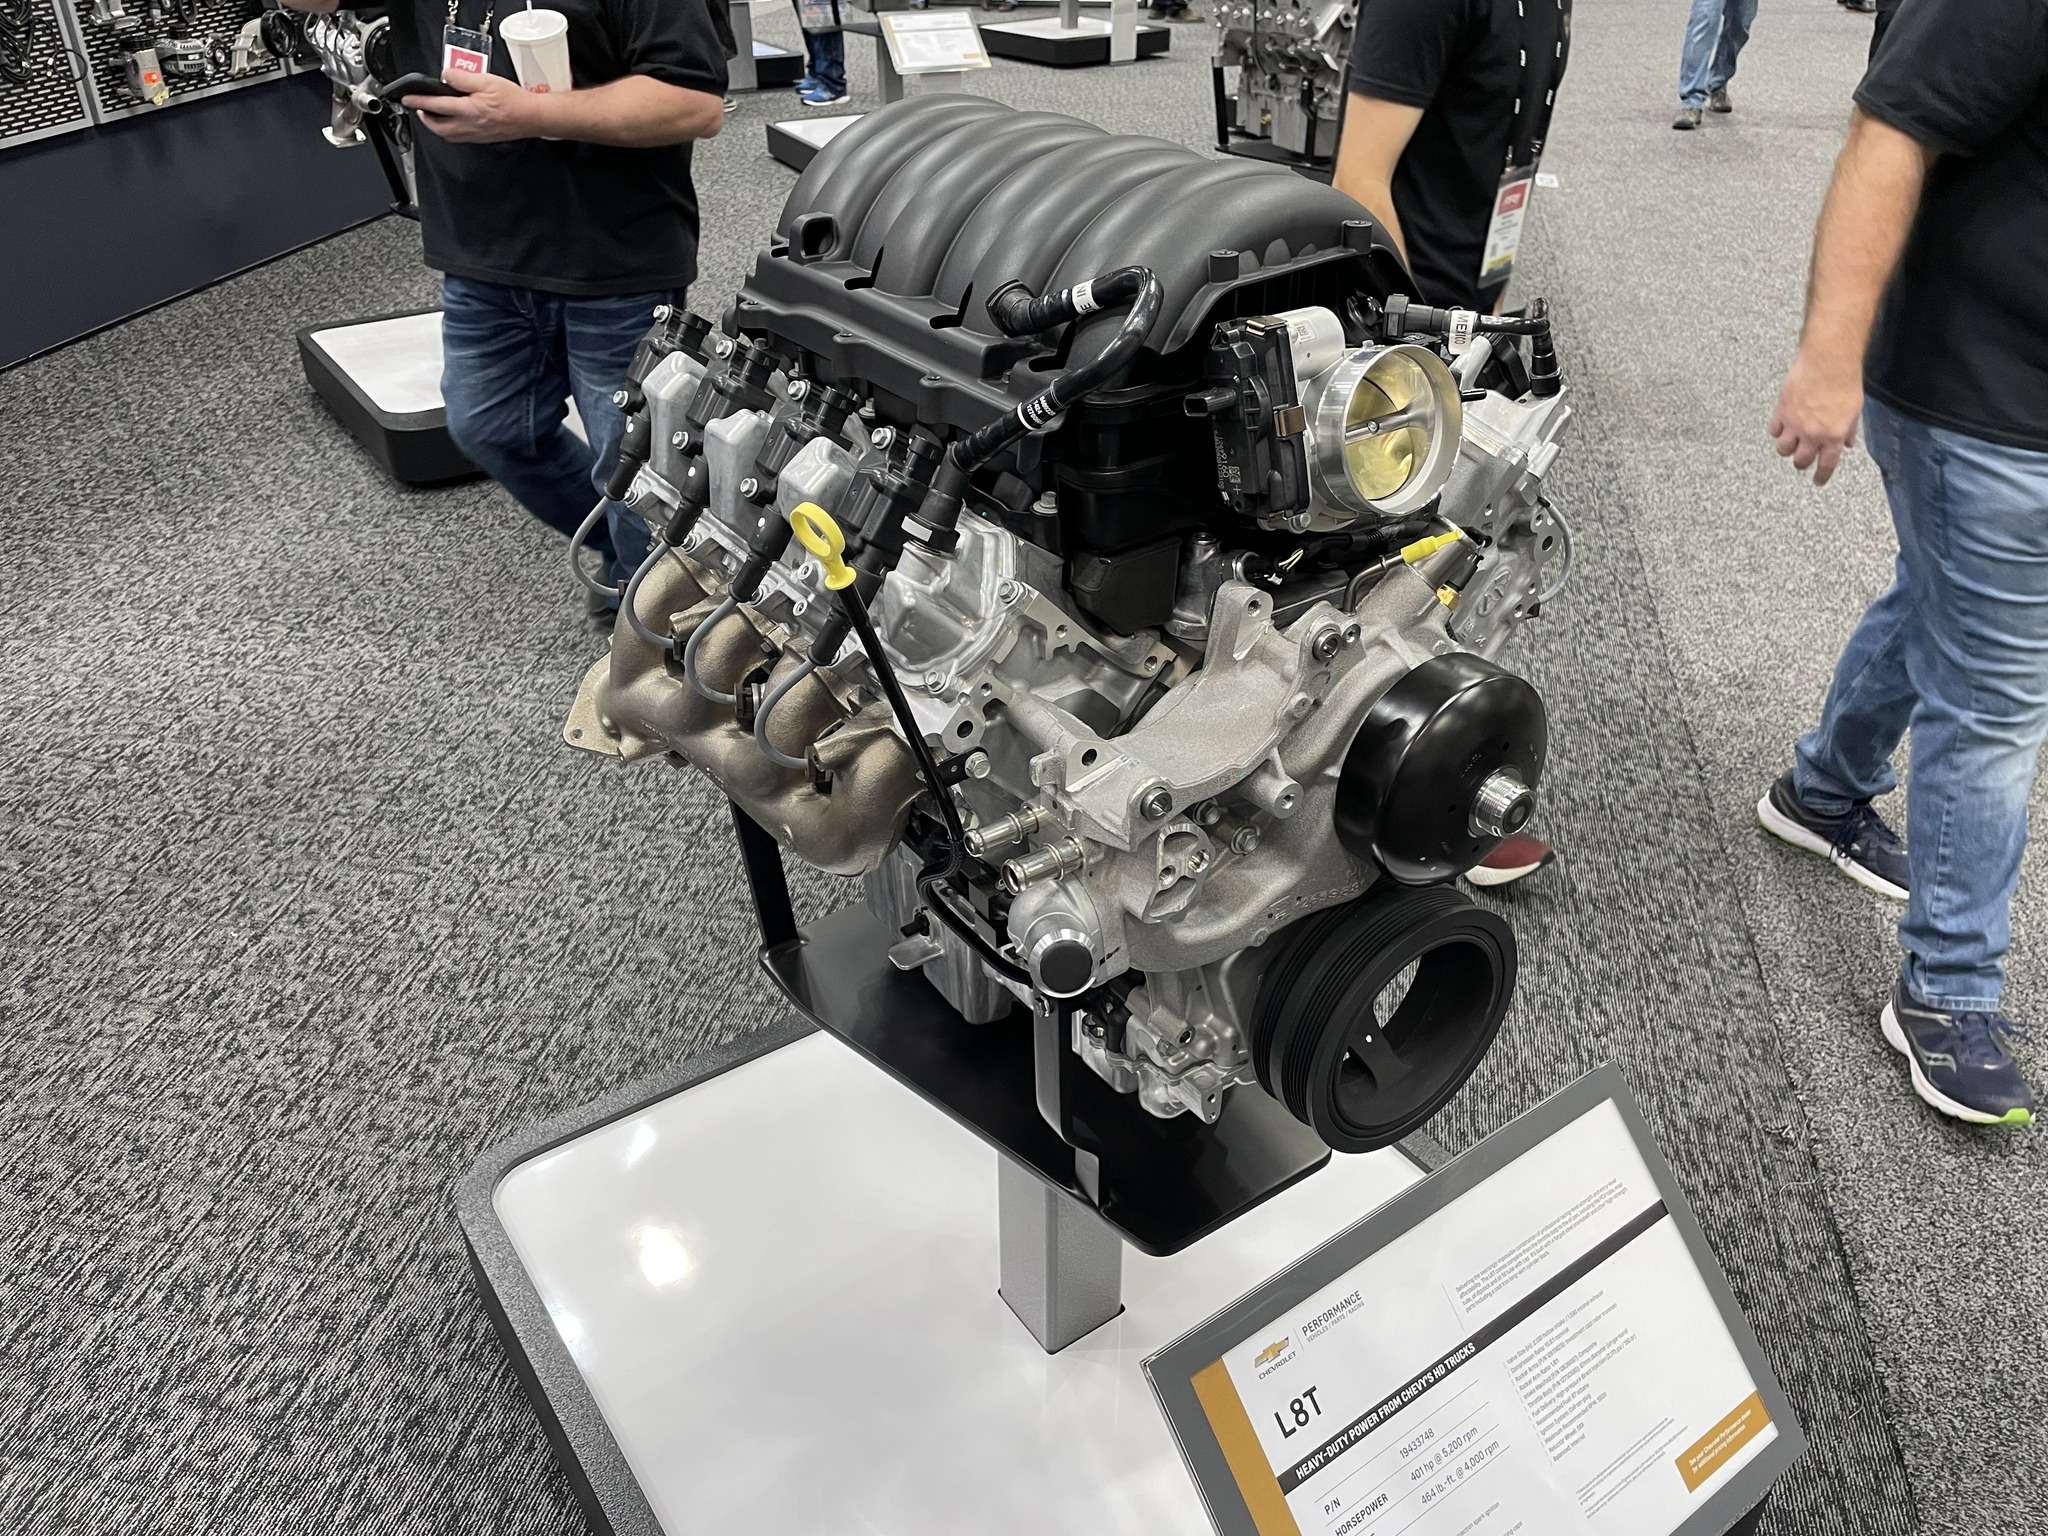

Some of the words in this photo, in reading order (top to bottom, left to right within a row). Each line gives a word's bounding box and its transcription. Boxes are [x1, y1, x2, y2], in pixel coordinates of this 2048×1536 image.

[455, 58, 478, 72] PRI
[1301, 1289, 1362, 1336] PERFORMANCE
[1306, 1324, 1328, 1343] VEHICLES
[1330, 1313, 1345, 1326] PARTS
[1347, 1300, 1364, 1315] RACING
[1258, 1350, 1297, 1380] CHEVROLET
[1273, 1384, 1326, 1439] L8T
[1295, 1432, 1350, 1480] HEAVY-DUTY
[1347, 1411, 1380, 1441] POWER
[1377, 1395, 1402, 1419] FROM
[1399, 1371, 1435, 1403] CHEVY'S
[1432, 1363, 1446, 1379] HD
[1443, 1341, 1476, 1371] TRUCKS
[1323, 1496, 1341, 1515] P/N
[1399, 1426, 1435, 1460] 19433748
[1334, 1492, 1389, 1536] HORSEPOWER
[1409, 1464, 1424, 1482] 401
[1422, 1457, 1436, 1474] hp
[1432, 1451, 1443, 1466] @
[1440, 1435, 1463, 1459] 5,200
[1462, 1426, 1479, 1444] rpm
[1419, 1487, 1436, 1506] 464
[1434, 1471, 1456, 1494] lb.-ft.
[1454, 1465, 1465, 1480] @
[1462, 1449, 1486, 1473] 4,000
[1484, 1440, 1501, 1458] rpm
